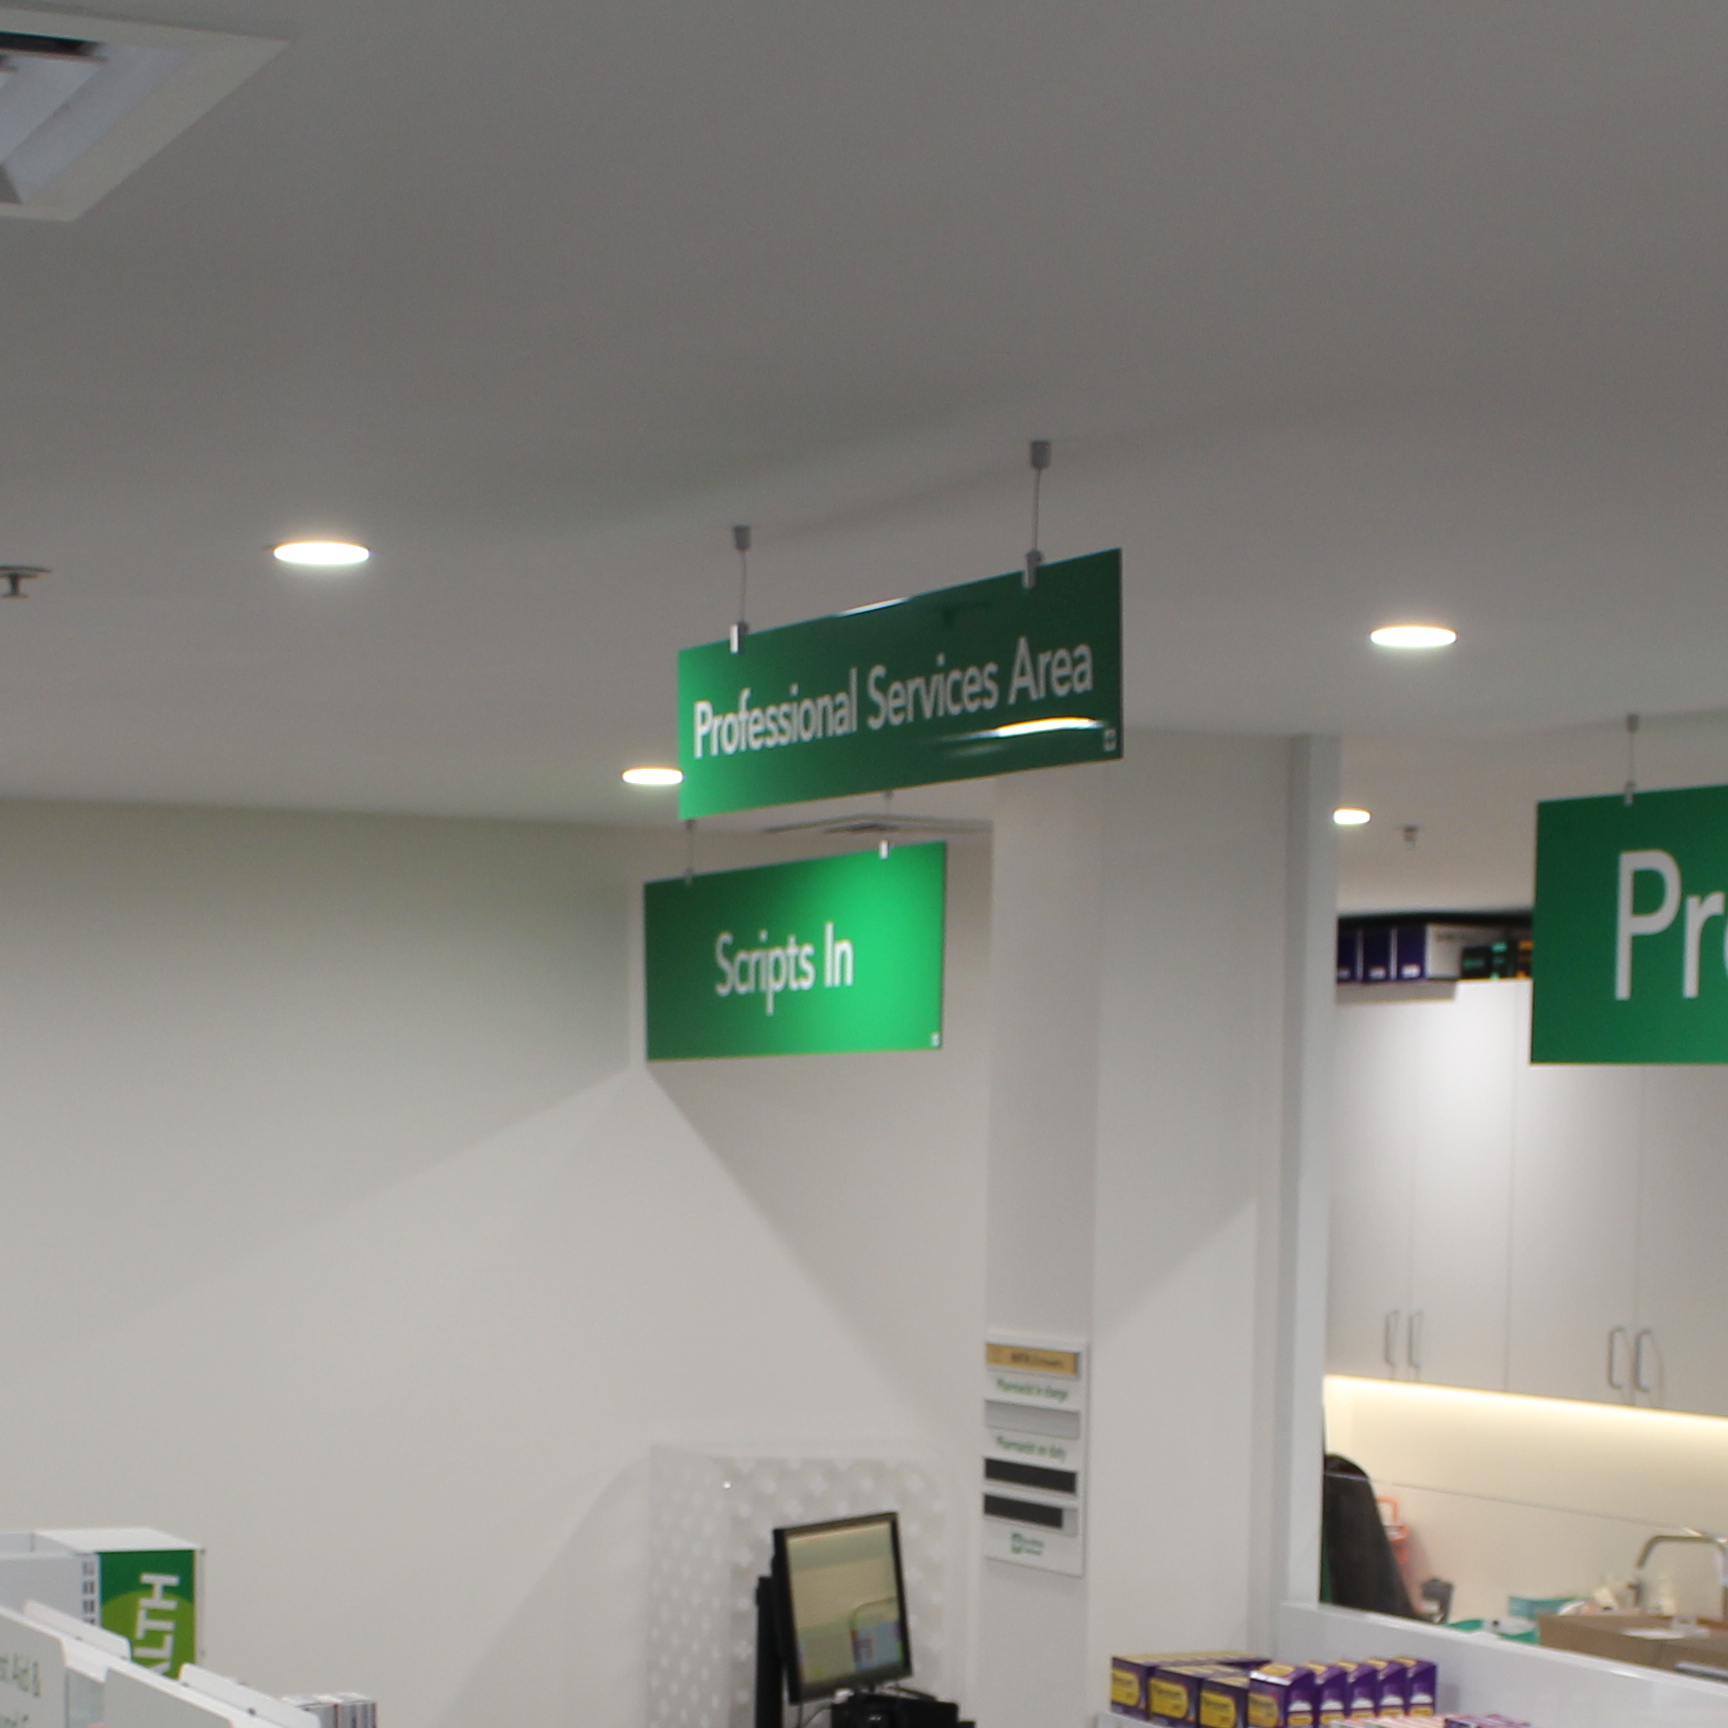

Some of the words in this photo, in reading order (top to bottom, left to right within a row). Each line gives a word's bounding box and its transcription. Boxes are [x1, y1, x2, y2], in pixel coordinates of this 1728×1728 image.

[694, 668, 858, 758] Professional
[867, 653, 998, 730] Services
[1008, 636, 1094, 704] Area
[715, 930, 815, 1016] Scripts
[824, 922, 853, 986] In
